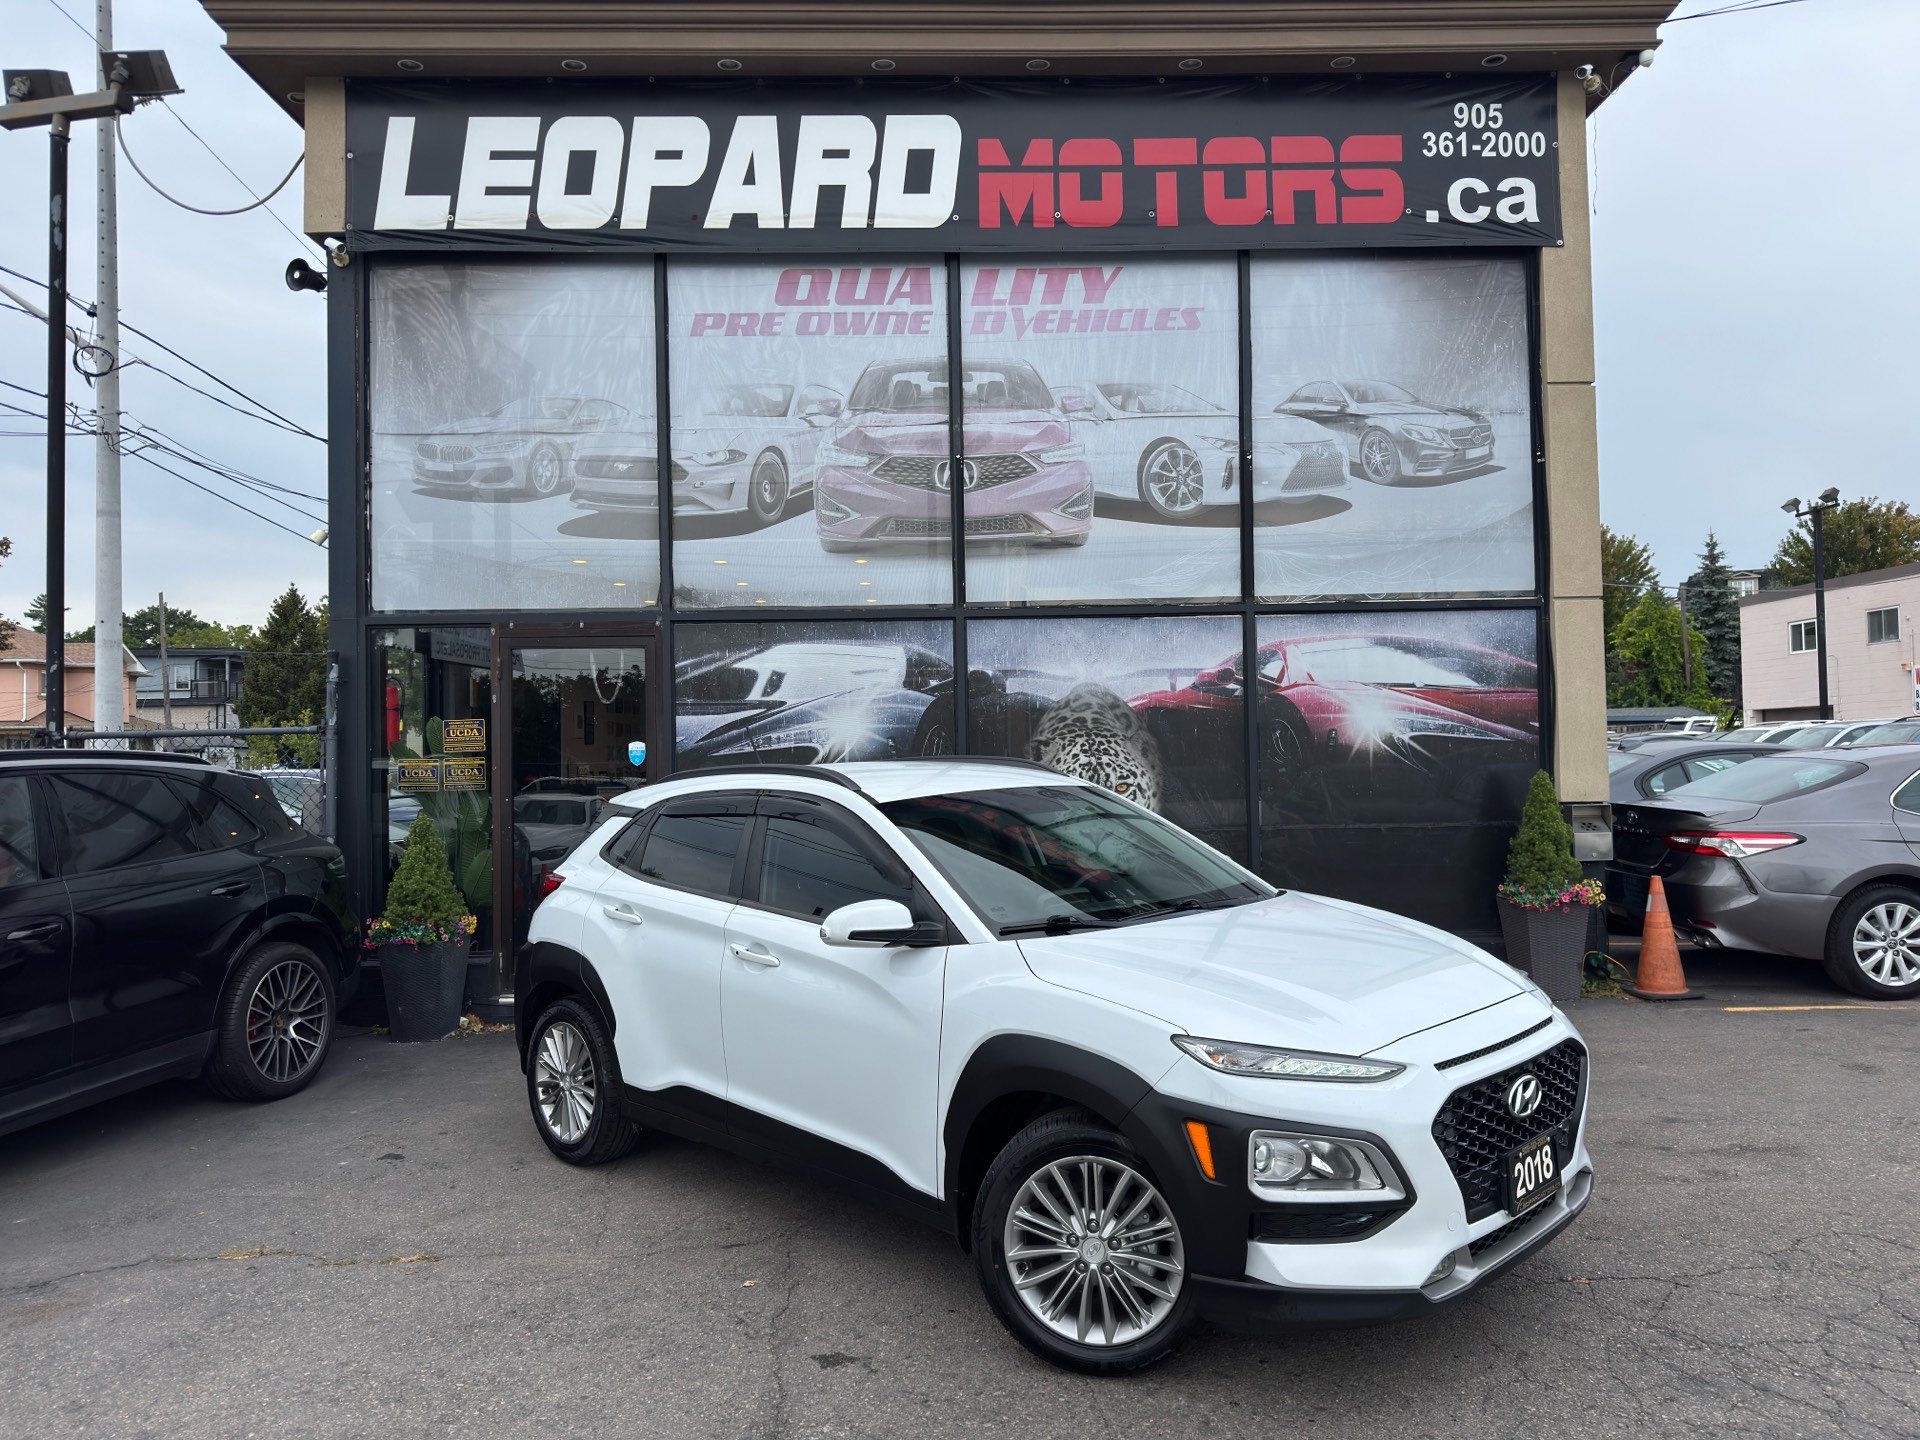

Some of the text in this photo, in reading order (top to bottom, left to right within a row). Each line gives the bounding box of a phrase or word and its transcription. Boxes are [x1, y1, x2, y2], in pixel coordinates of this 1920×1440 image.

[1453, 102, 1503, 129] 905
[1422, 131, 1546, 157] 361-2000
[374, 115, 1540, 230] LEOPARD MOTORS .ca
[774, 266, 1124, 306] QUA LITY
[690, 312, 786, 337] PRE
[450, 728, 479, 737] UCDA
[405, 769, 433, 777] UCDA
[450, 768, 479, 776] UCDA
[1514, 1145, 1553, 1199] 2018
